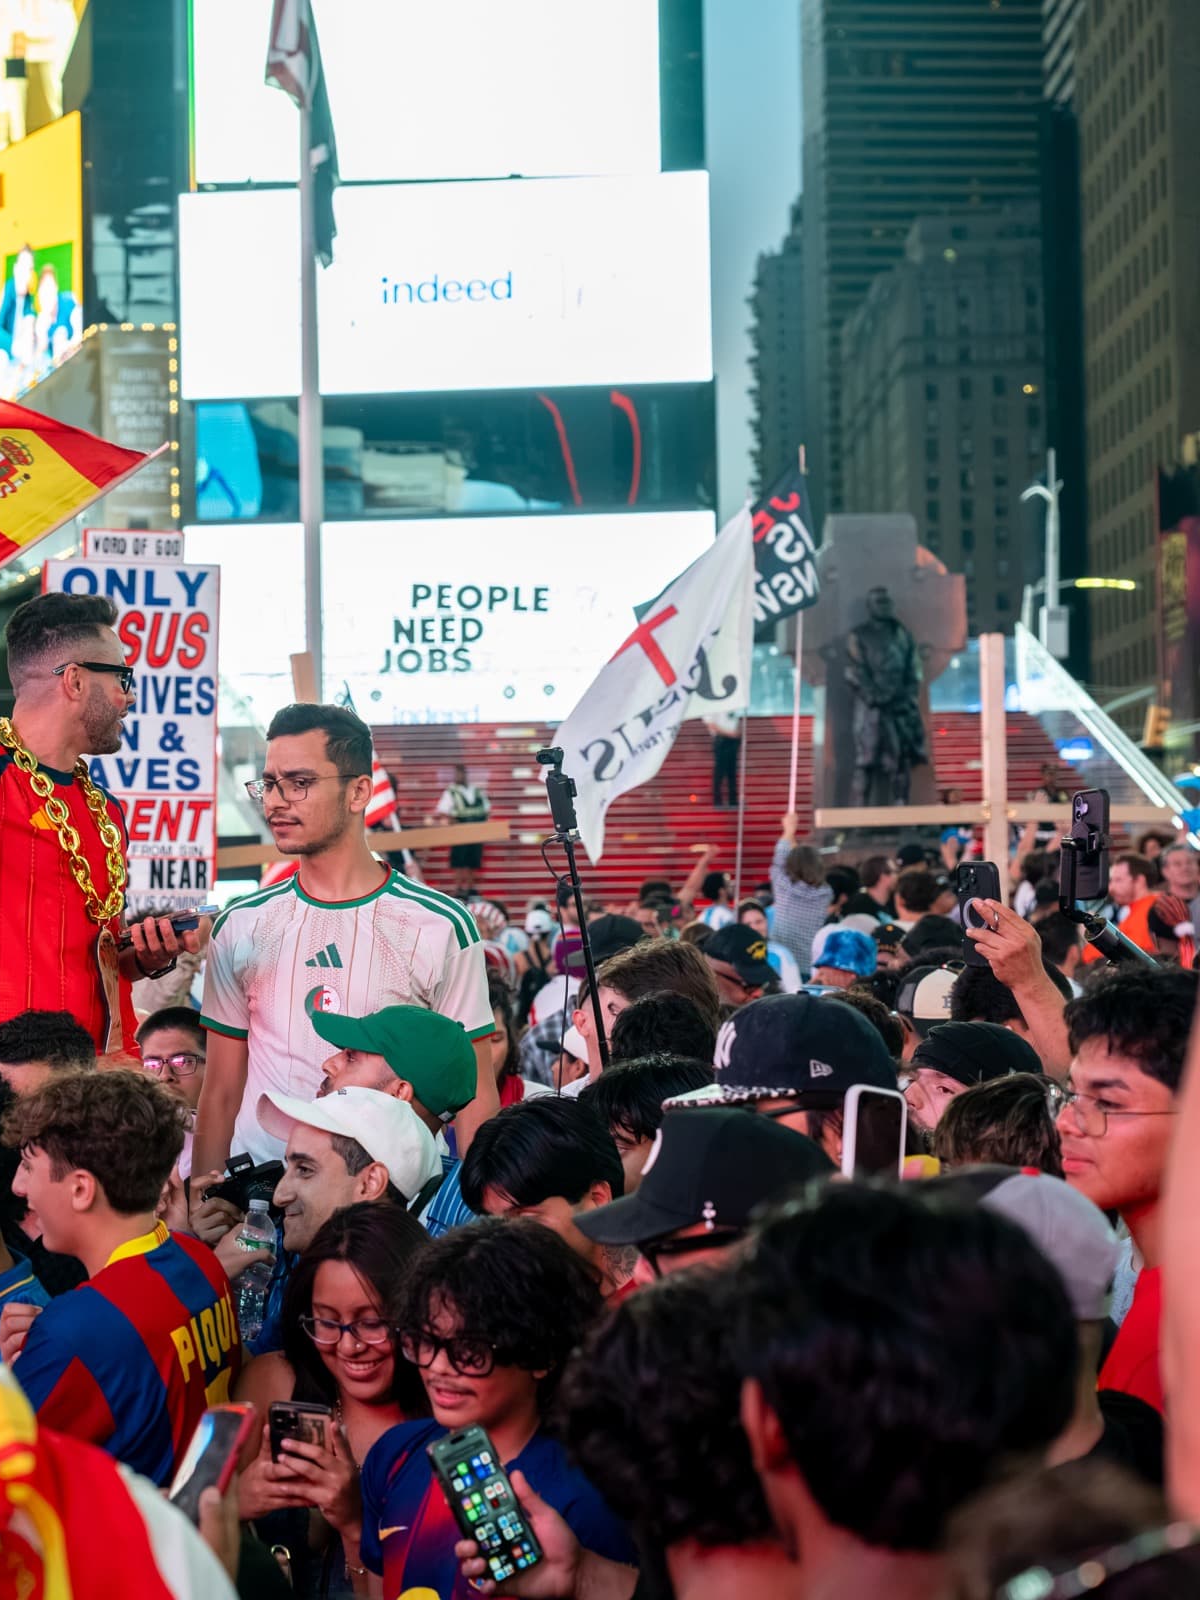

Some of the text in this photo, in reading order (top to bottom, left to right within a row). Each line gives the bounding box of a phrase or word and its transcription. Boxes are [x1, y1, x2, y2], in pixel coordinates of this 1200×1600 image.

[381, 270, 513, 304] indeed
[93, 536, 182, 556] WORD OF GOD
[62, 566, 209, 607] ONLY
[412, 583, 549, 613] PEOPLE
[118, 609, 210, 670] SUS
[393, 617, 484, 644] NEED
[379, 646, 473, 675] JOBS
[128, 674, 215, 715] IVES
[159, 721, 185, 753] &
[88, 757, 201, 791] AVES
[121, 799, 213, 842] ENT
[132, 844, 204, 857] FROM SIN
[150, 857, 207, 889] NEAR
